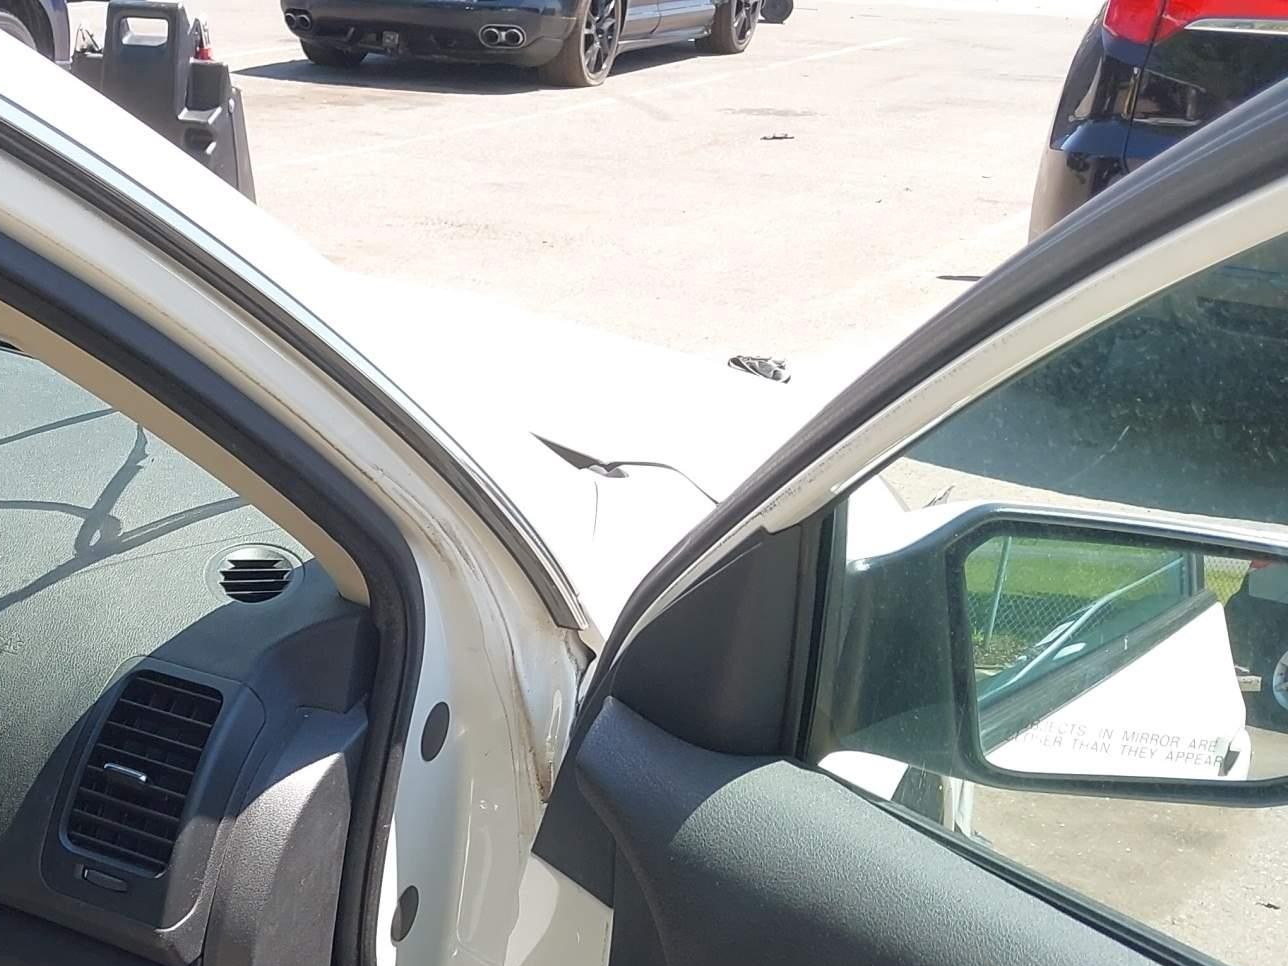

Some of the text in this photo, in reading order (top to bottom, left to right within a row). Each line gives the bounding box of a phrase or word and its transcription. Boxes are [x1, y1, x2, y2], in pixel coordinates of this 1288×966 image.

[1073, 738, 1111, 754] THAN
[1120, 744, 1158, 759] THEY
[1165, 751, 1224, 769] APPEAR
[1098, 728, 1114, 740] IN
[1122, 730, 1180, 749] MIRROR
[1188, 738, 1218, 753] ARE
